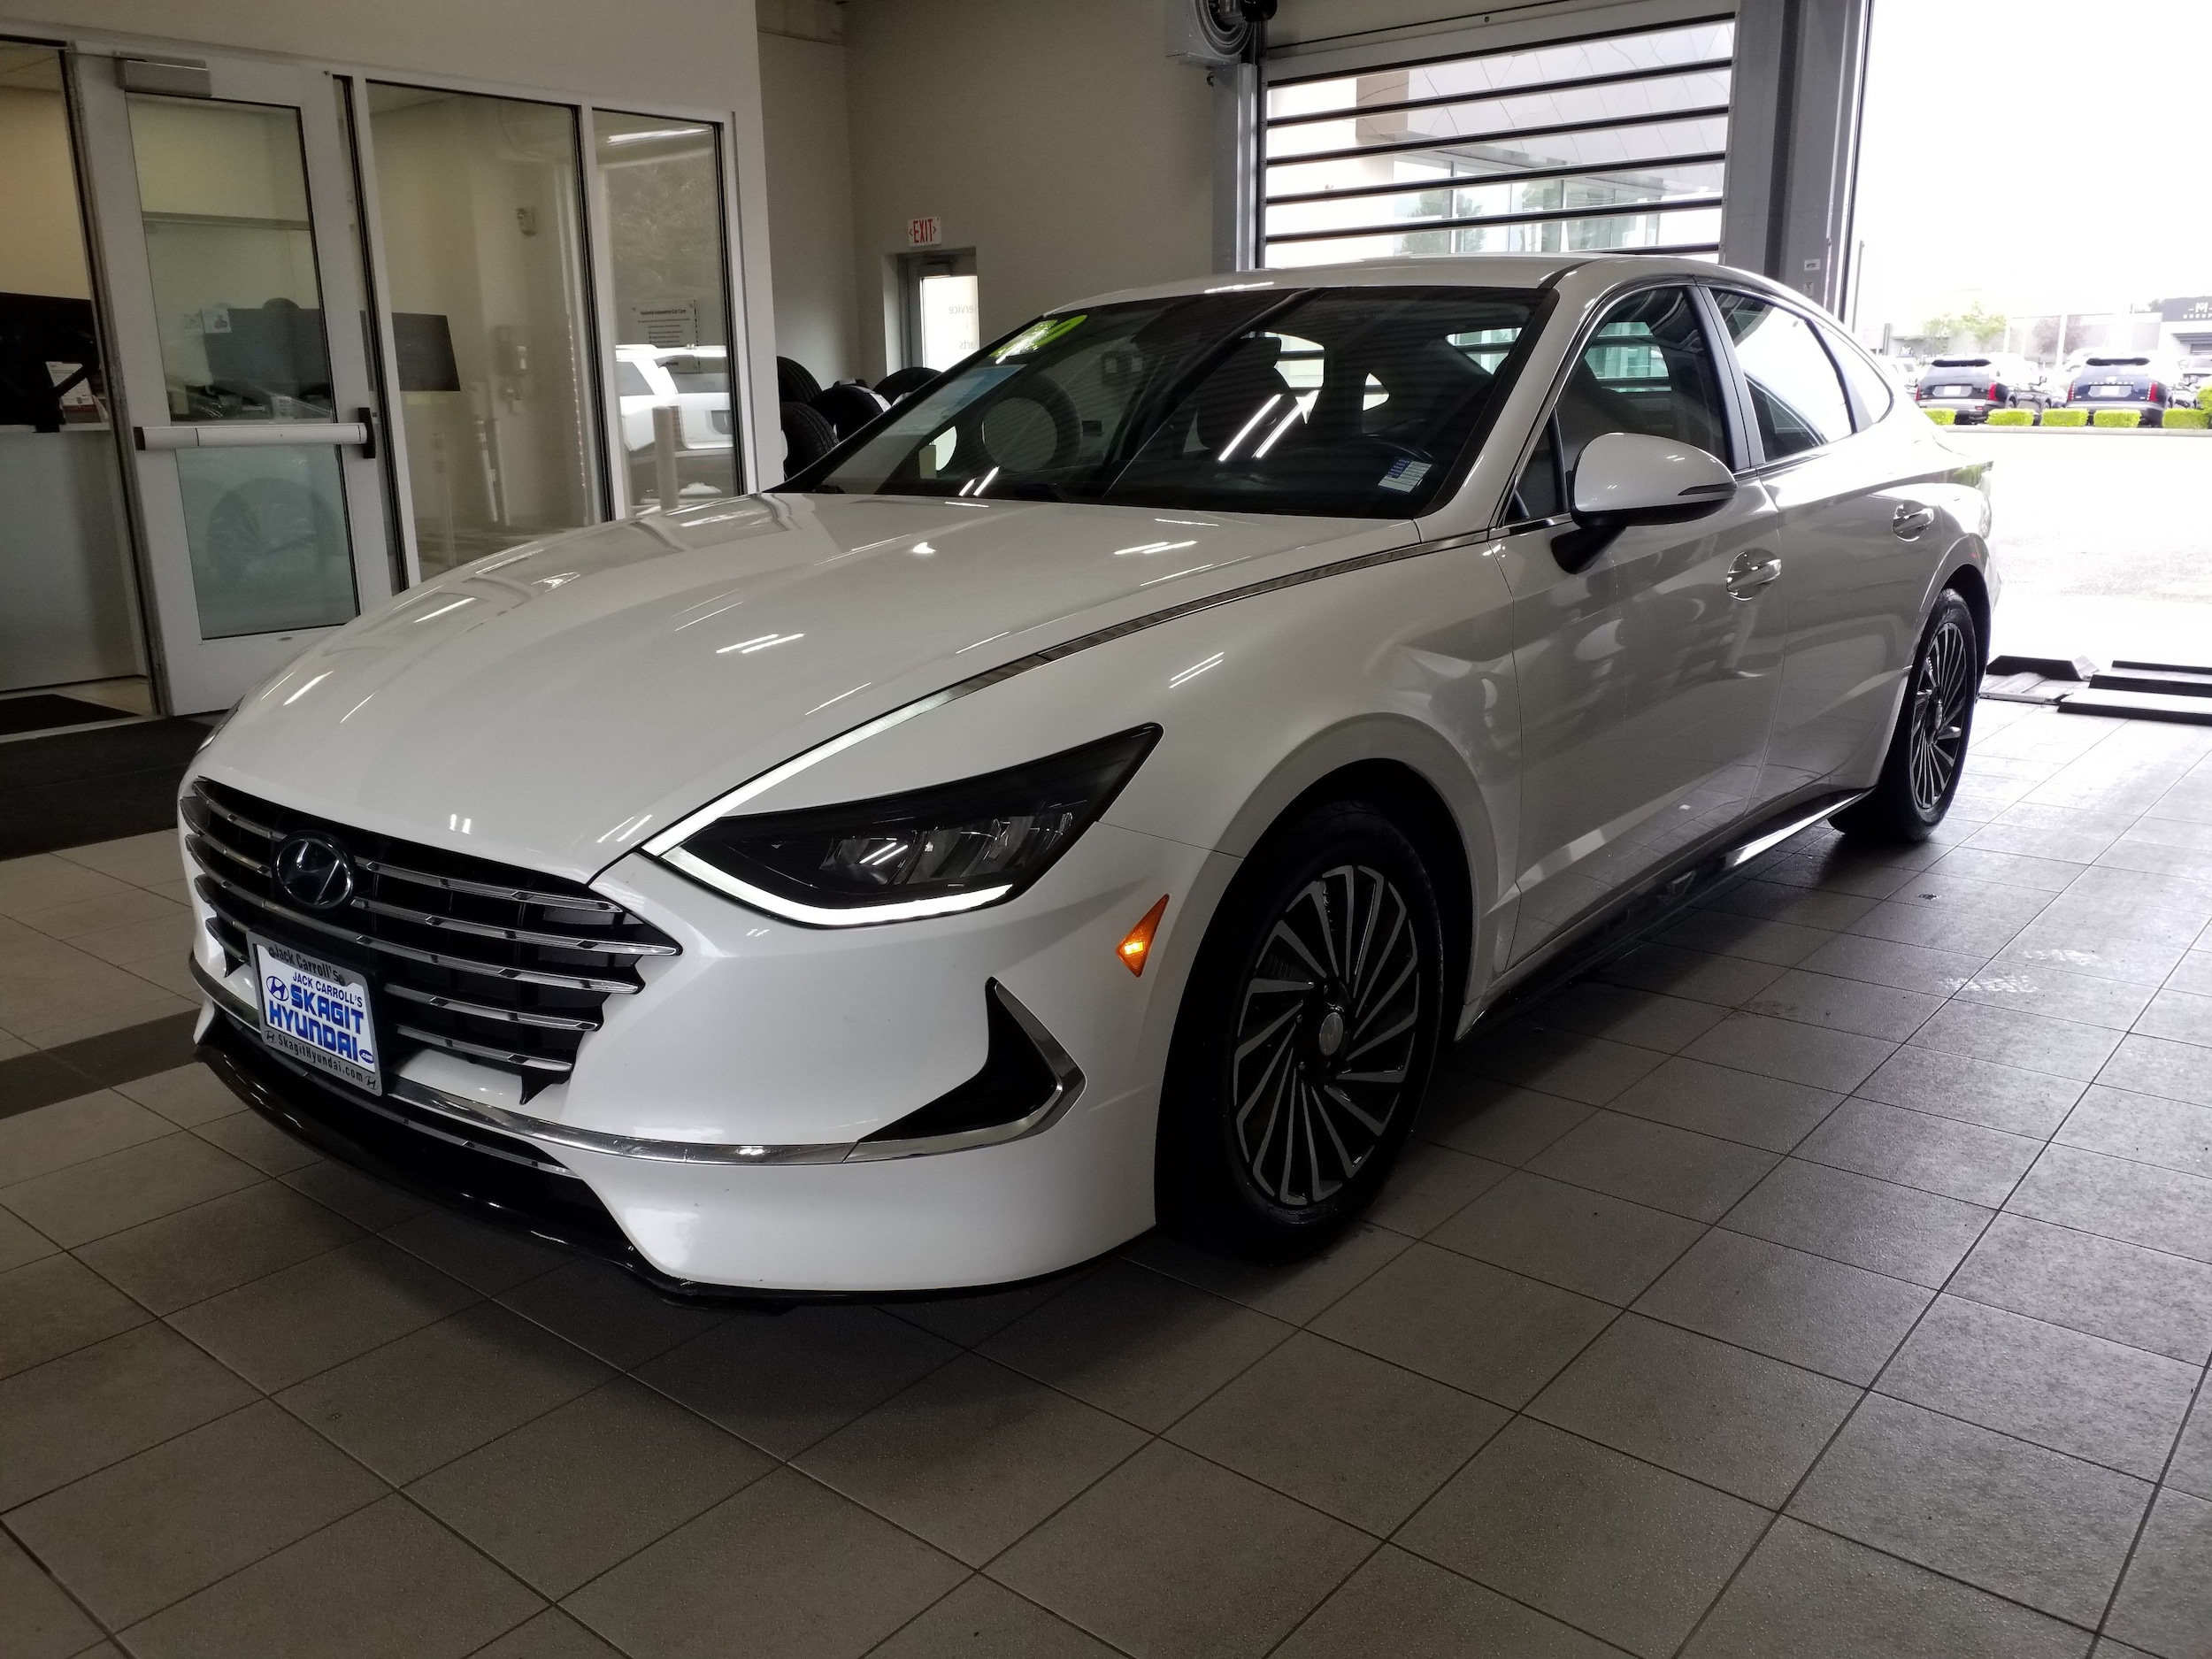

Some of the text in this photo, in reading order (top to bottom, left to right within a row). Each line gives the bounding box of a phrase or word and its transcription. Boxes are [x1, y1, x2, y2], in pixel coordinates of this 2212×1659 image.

[913, 219, 933, 243] EXIT
[275, 944, 340, 982] Jack Carroll's
[290, 984, 365, 1035] SKAGIT
[293, 972, 364, 1008] JACK CARROLL'S
[269, 999, 359, 1063] HYUNDAI
[278, 1033, 364, 1083] SkagitHyundai.com
